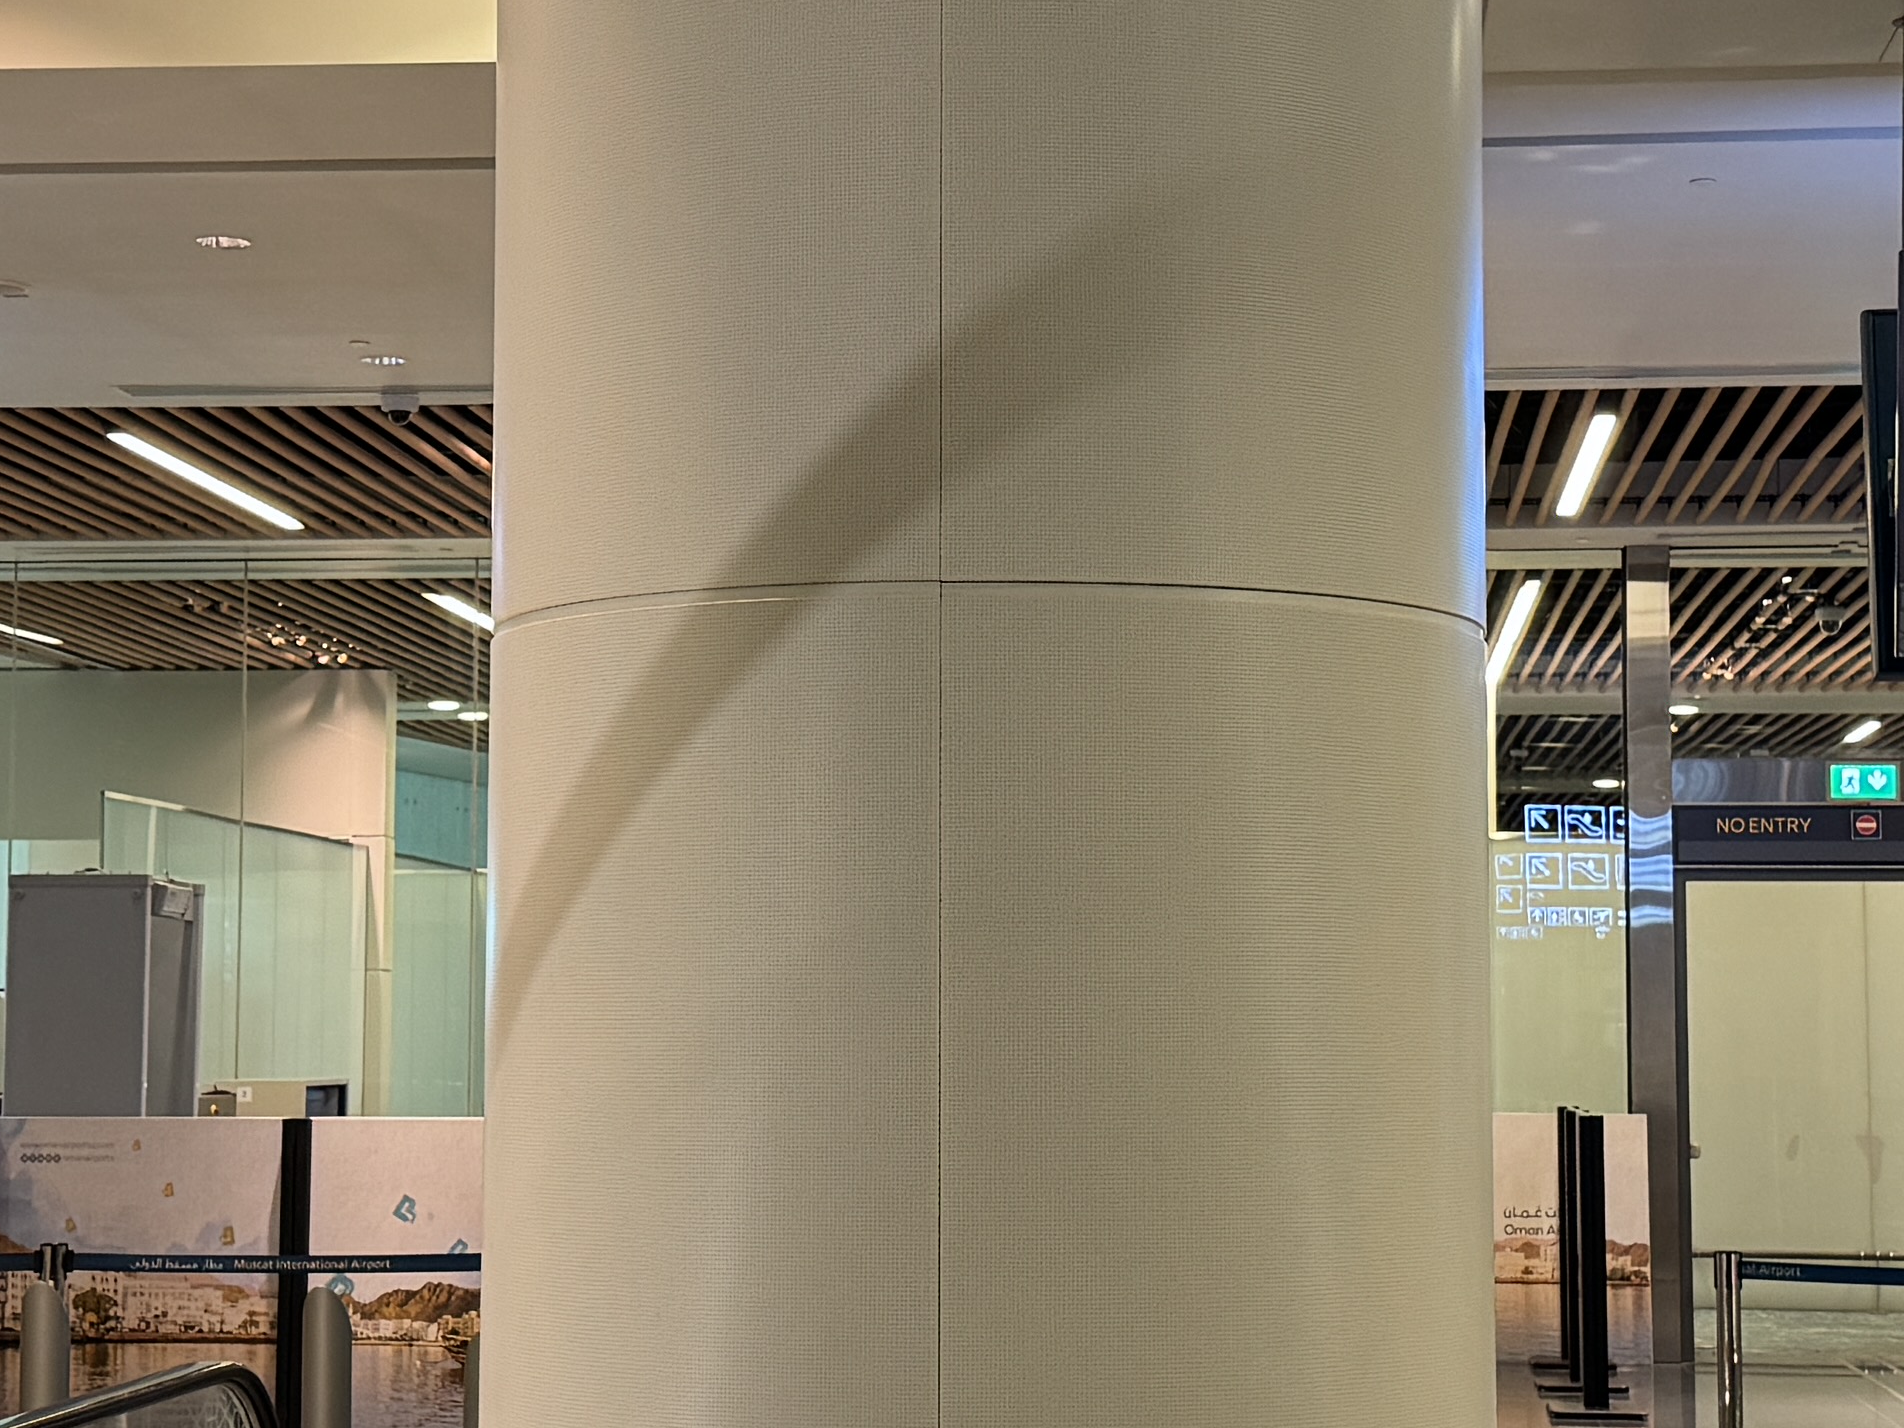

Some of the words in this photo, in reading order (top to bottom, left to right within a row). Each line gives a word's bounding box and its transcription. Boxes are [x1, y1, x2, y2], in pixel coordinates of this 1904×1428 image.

[1715, 817, 1746, 834] NO
[1748, 817, 1812, 834] ENTRY
[1503, 1223, 1544, 1236] Oman
[233, 1258, 273, 1270] Muscat
[275, 1258, 348, 1270] International
[350, 1258, 391, 1271] Airport
[1758, 1264, 1801, 1277] Airport
